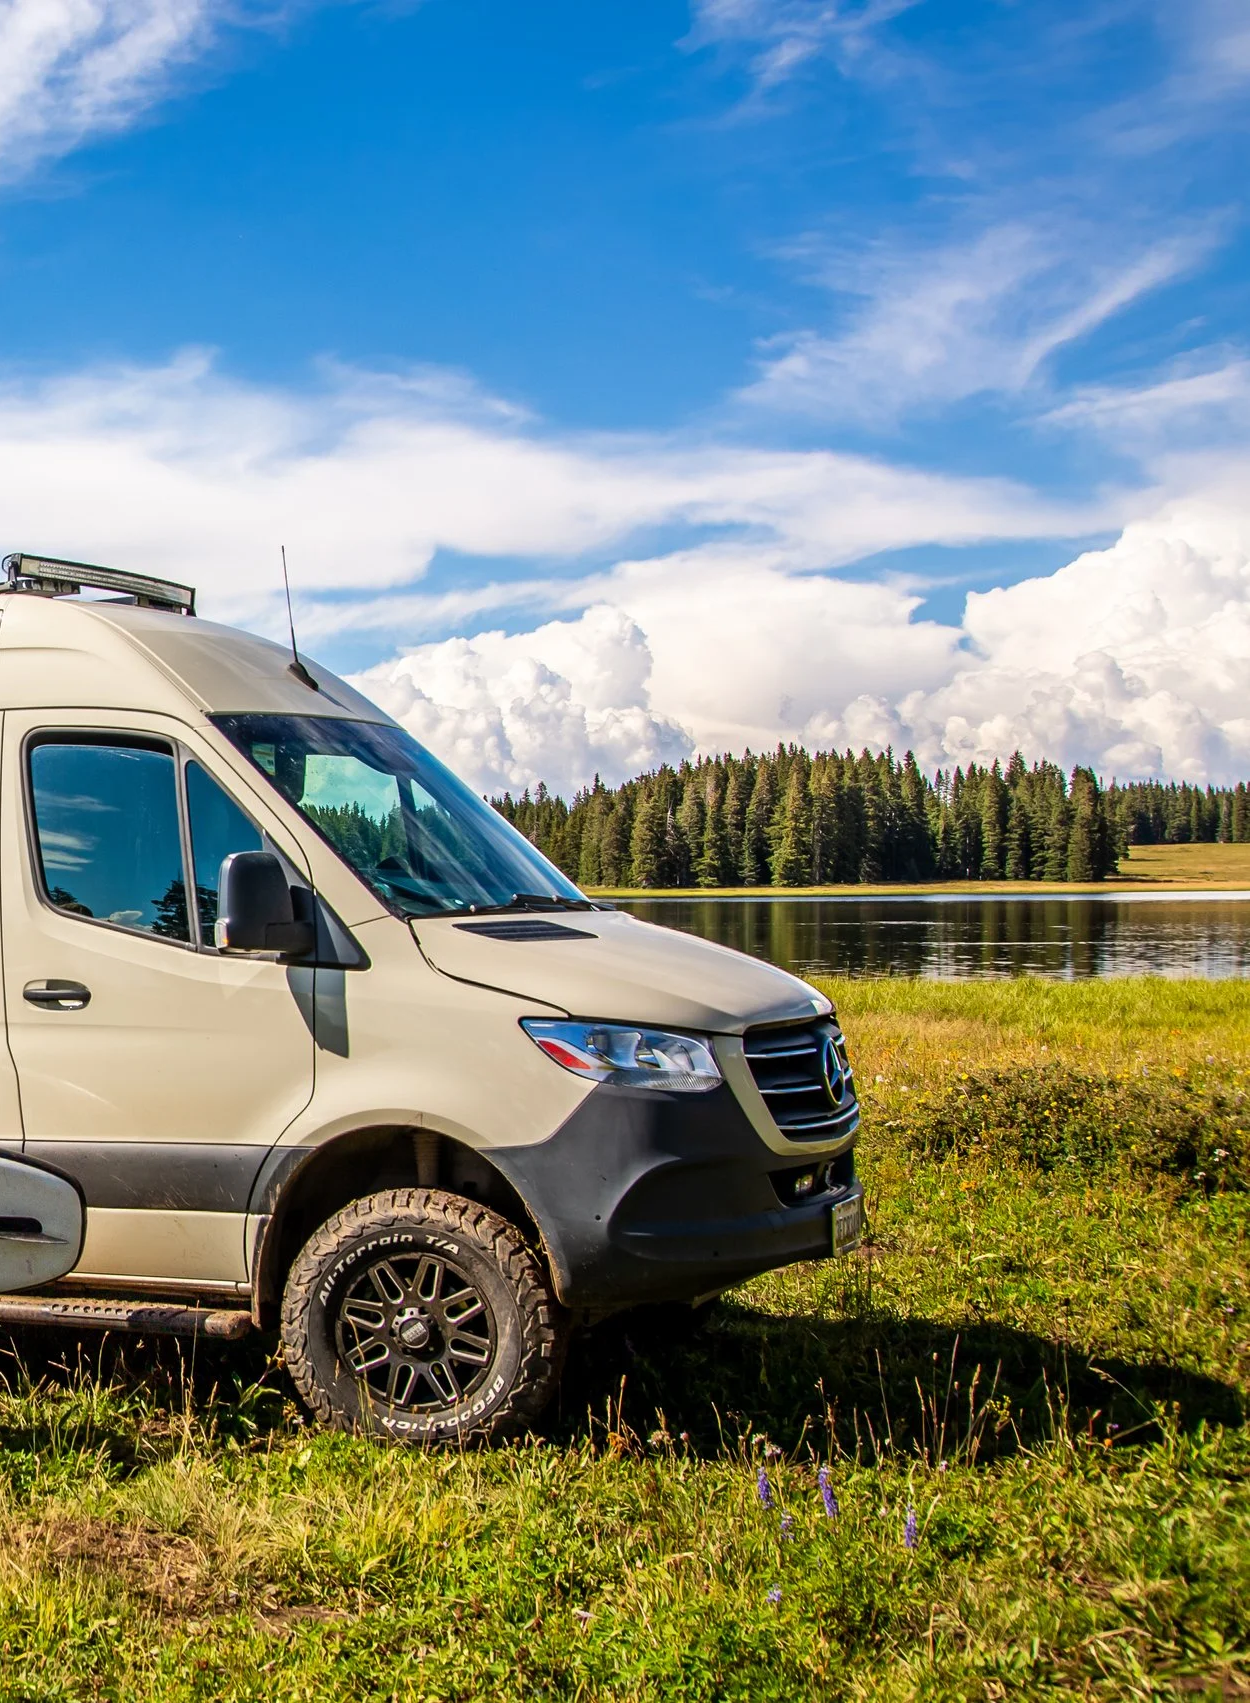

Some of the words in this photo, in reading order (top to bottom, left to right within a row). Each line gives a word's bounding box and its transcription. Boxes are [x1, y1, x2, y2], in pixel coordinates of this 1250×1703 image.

[319, 1233, 413, 1306] All-Terrain
[425, 1234, 460, 1255] T/A
[381, 1374, 505, 1432] BFGoodrich
